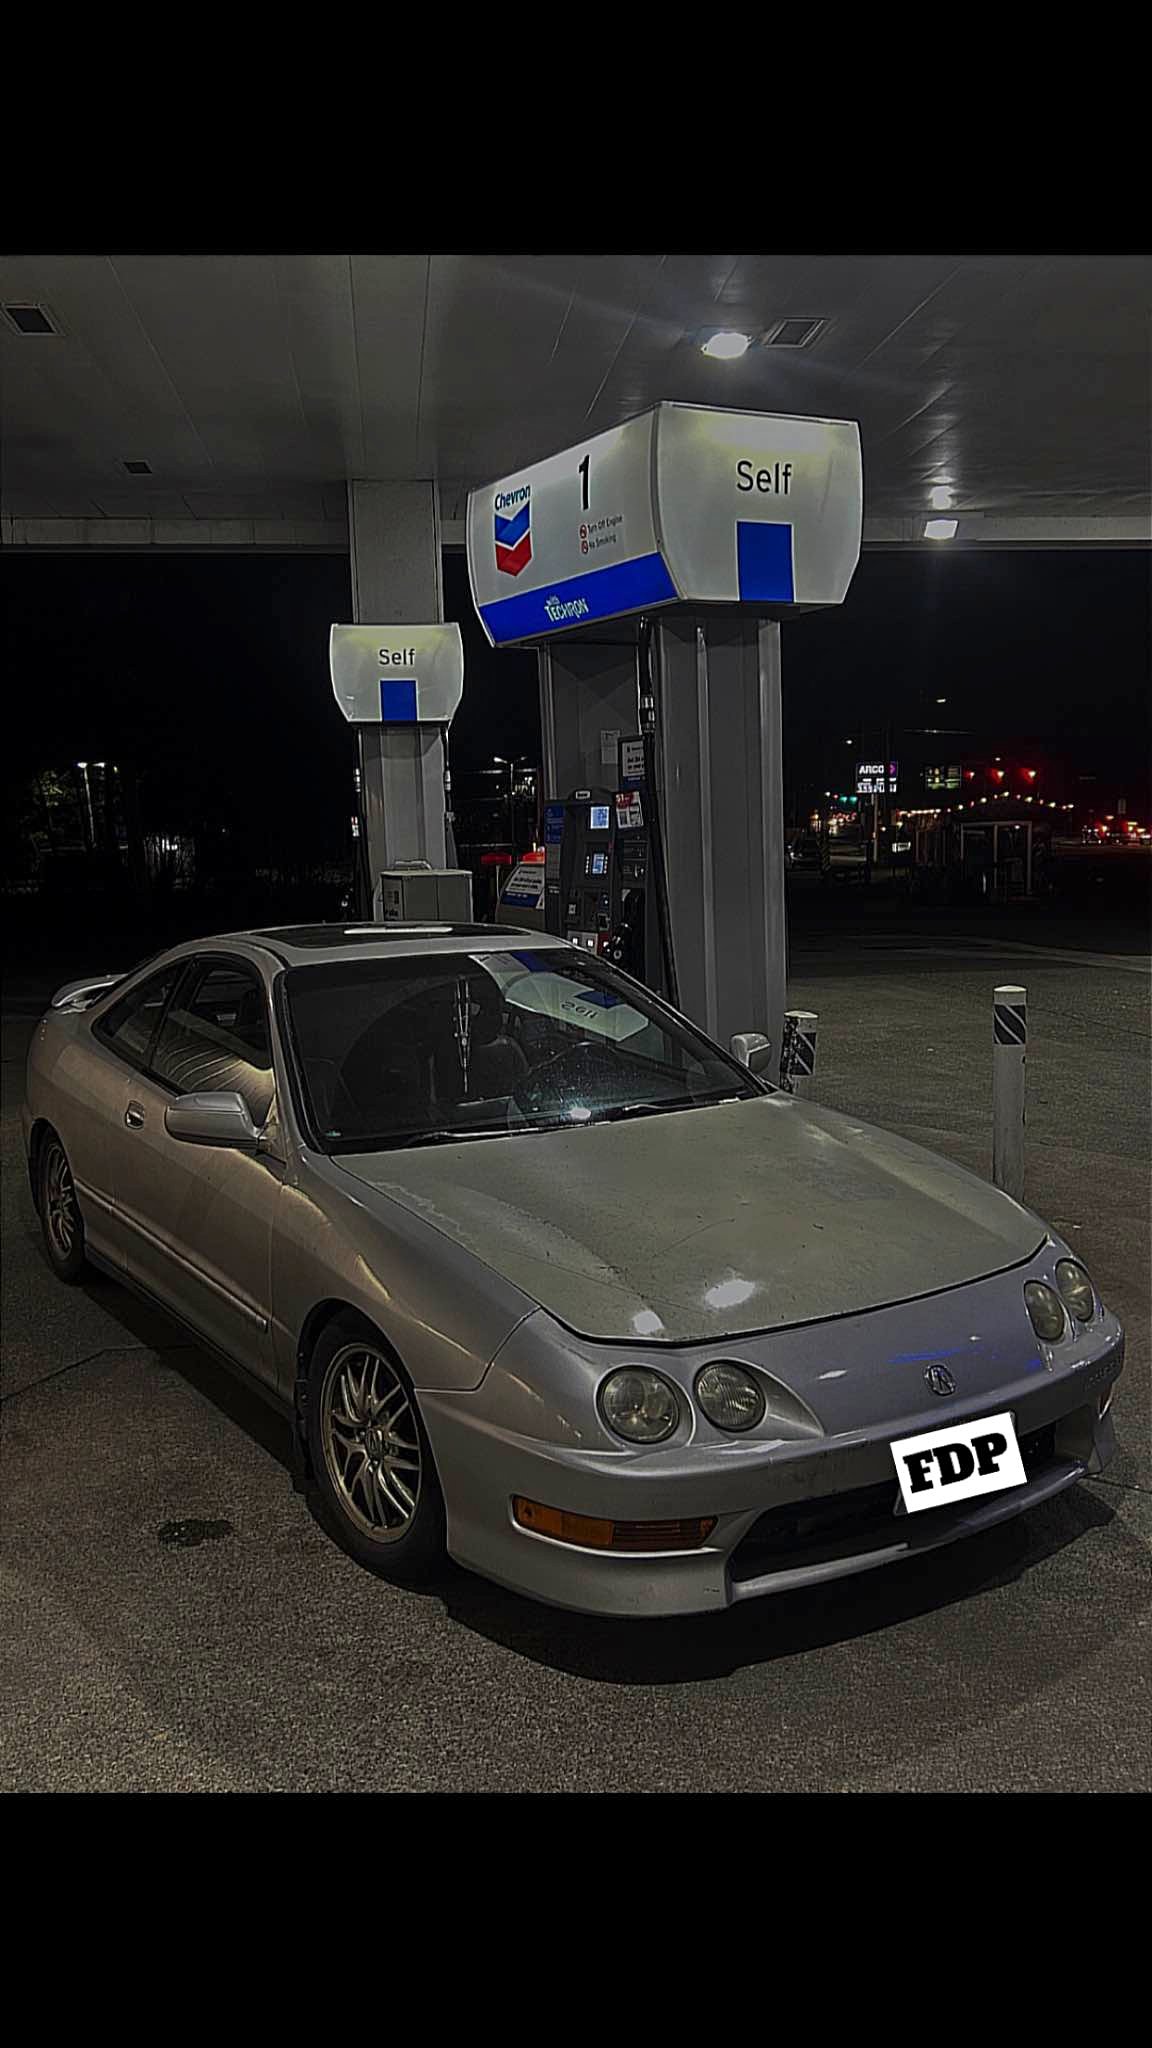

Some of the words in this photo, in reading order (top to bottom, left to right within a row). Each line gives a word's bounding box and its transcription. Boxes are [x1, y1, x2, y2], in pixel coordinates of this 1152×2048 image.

[578, 454, 590, 511] 1
[735, 460, 792, 496] Self
[495, 486, 530, 510] Chevron
[544, 598, 589, 622] TECHRON
[379, 648, 415, 665] Self
[859, 765, 884, 774] ARCO
